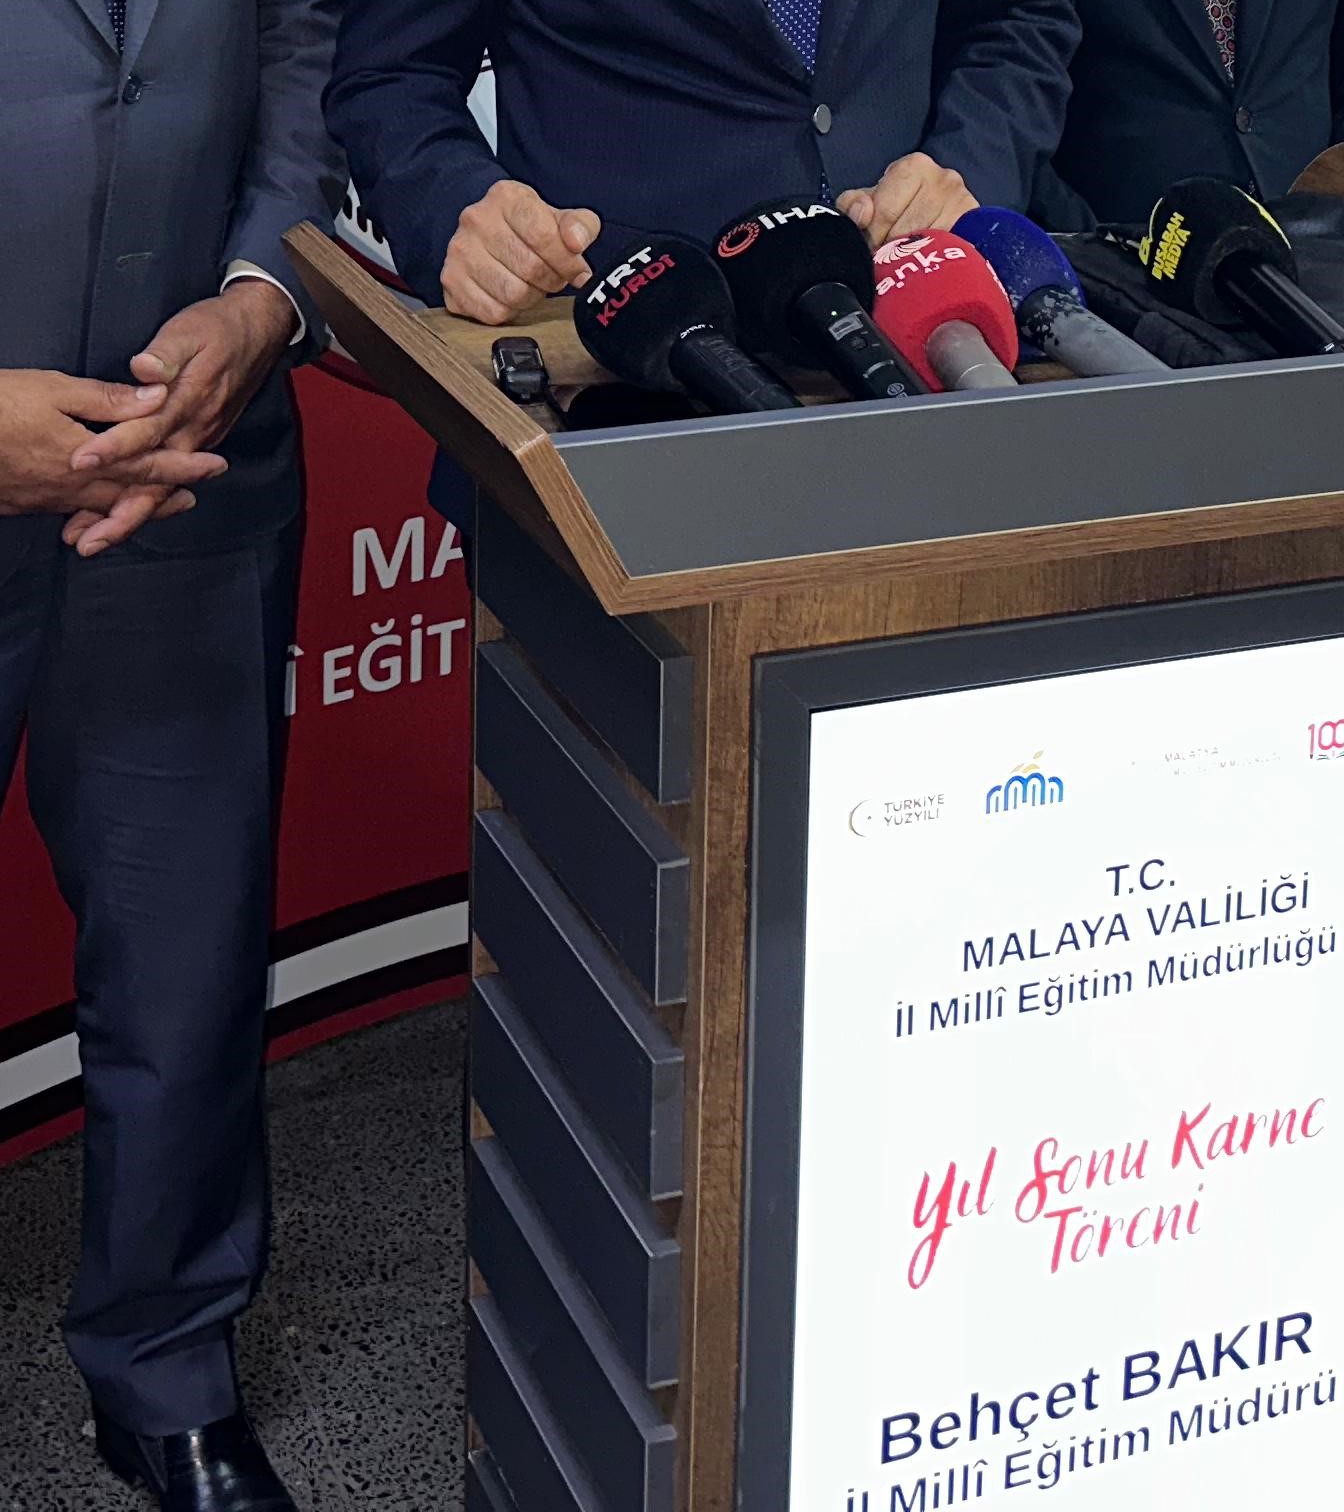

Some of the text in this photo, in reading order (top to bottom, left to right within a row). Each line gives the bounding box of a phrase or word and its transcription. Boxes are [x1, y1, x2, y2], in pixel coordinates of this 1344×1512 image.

[587, 246, 652, 305] TRT
[962, 871, 1310, 973] MALAYA VALİLİĞİ
[1105, 858, 1176, 897] T.C.
[929, 986, 1008, 1031] Millî
[1018, 969, 1133, 1016] Eğitim
[1147, 925, 1337, 988] Müdürlüğü
[908, 1146, 997, 1289] Yıl
[1014, 1137, 1149, 1223] Sonu
[880, 1310, 1314, 1465] Behçet BAKIR
[1004, 1426, 1150, 1491] Eğitim
[1168, 1368, 1338, 1446] Müdürü
